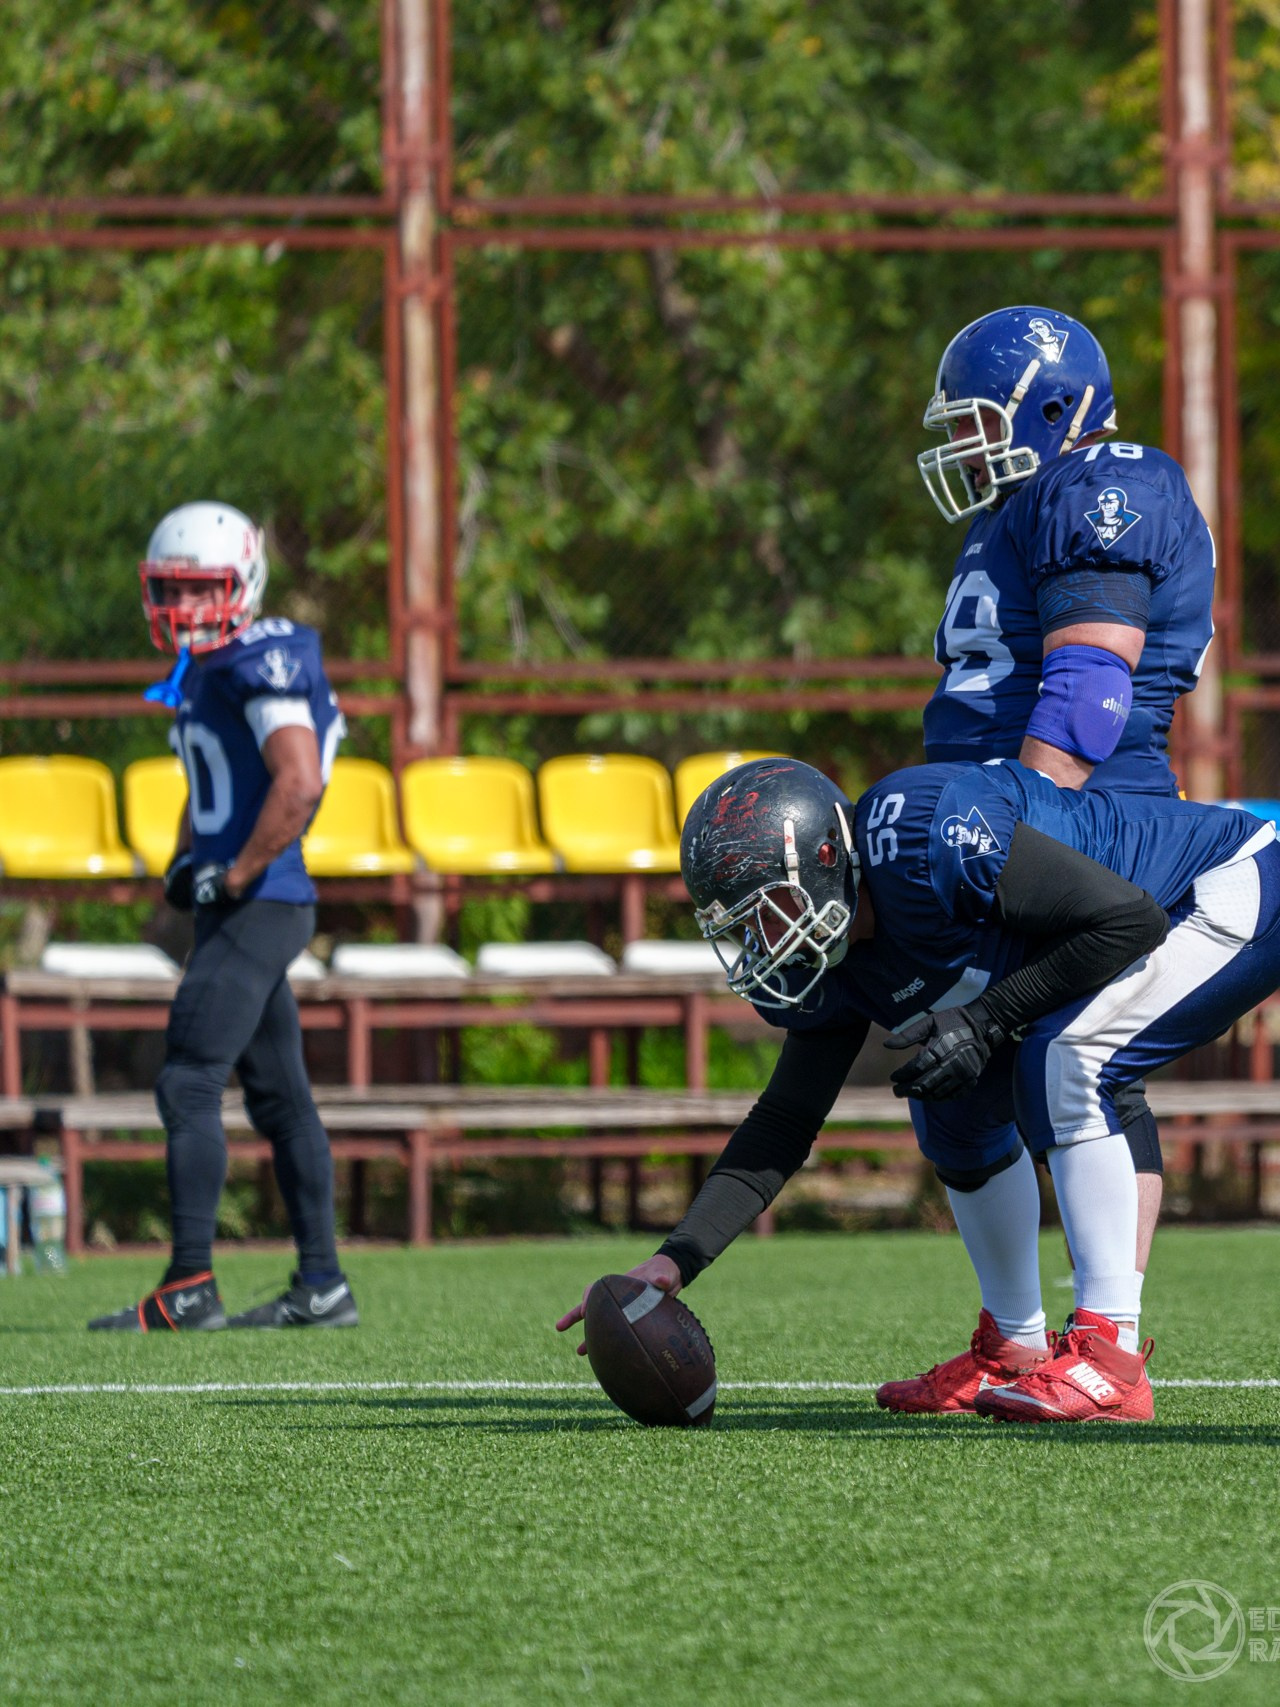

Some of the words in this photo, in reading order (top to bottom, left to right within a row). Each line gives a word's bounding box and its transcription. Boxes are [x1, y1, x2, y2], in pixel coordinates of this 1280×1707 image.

[1071, 437, 1143, 462] 78
[866, 793, 906, 867] 55
[1065, 1361, 1116, 1401] NIKE
